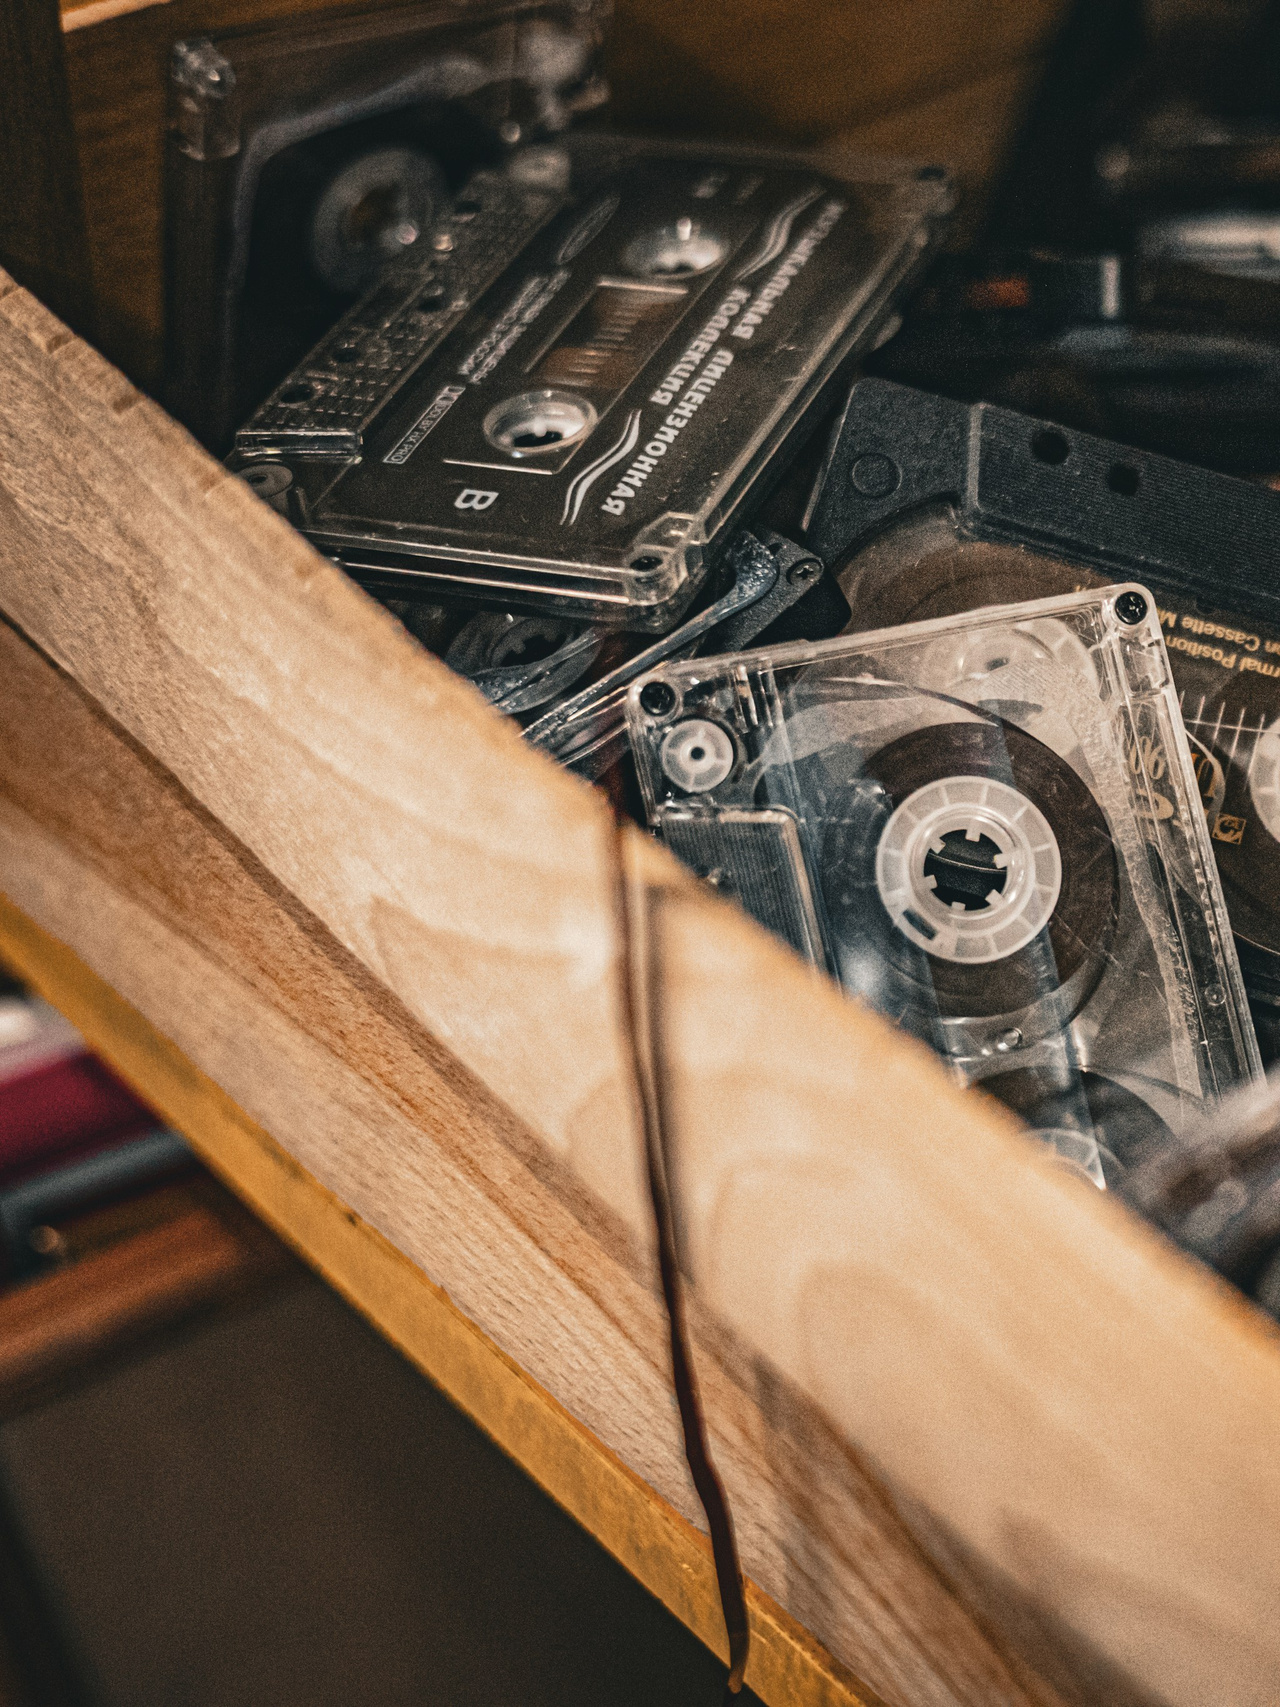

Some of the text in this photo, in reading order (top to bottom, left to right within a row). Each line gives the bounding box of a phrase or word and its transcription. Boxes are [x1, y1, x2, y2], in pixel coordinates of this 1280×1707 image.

[646, 288, 754, 404] КОЛЛЕКЦИЯ
[415, 404, 446, 429] DOLBY
[596, 349, 740, 514] ЛИЦЕНЗИОННАЯ
[388, 443, 413, 461] PRO
[455, 488, 497, 512] B
[1180, 615, 1261, 652] Cassette
[1164, 634, 1237, 668] Position
